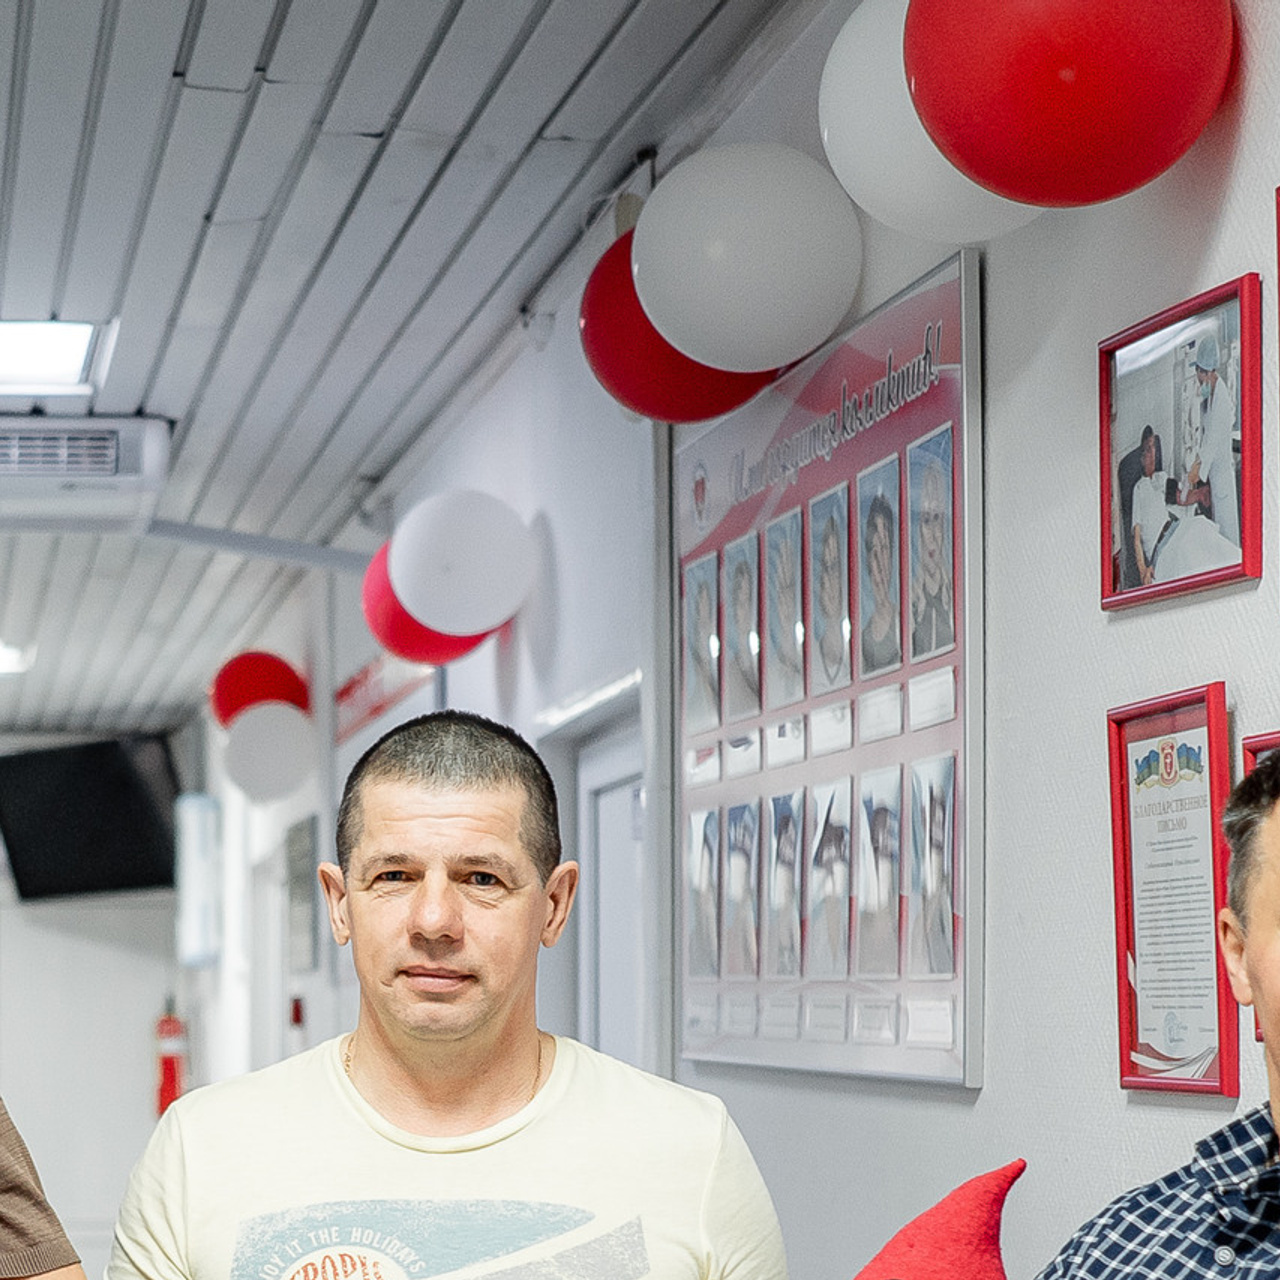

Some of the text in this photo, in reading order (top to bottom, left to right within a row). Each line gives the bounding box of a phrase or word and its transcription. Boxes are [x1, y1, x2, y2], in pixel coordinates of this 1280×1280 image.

[285, 1239, 303, 1258] IT
[308, 1226, 340, 1246] THE
[350, 1226, 426, 1273] HOLIDAYS
